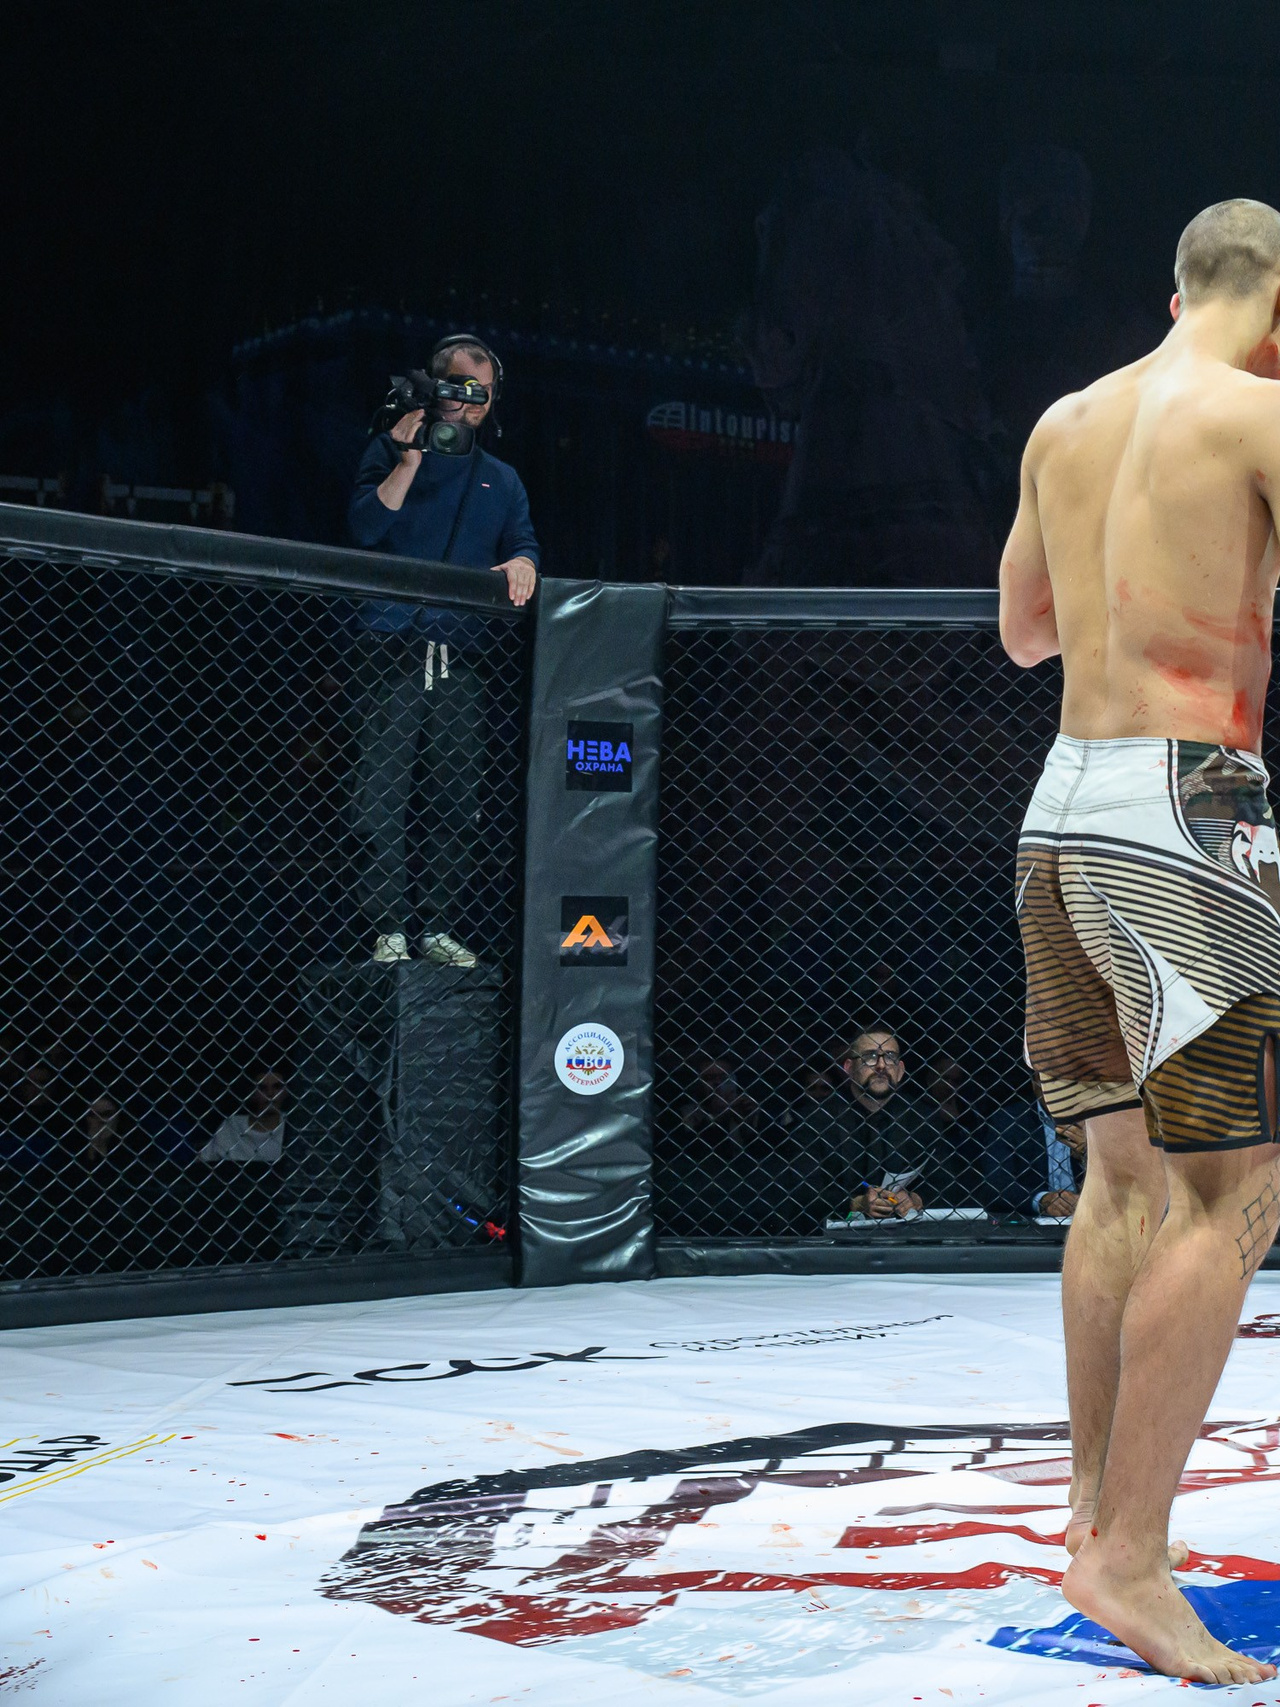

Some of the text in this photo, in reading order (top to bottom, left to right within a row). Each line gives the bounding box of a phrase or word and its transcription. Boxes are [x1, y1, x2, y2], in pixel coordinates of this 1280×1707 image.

[567, 739, 632, 762] НЕВА
[575, 761, 624, 773] ОХРАНА
[565, 1032, 615, 1053] АССОЦИАЦИЯ
[571, 1055, 607, 1069] СВО
[567, 1071, 610, 1086] ВЕТЕРАНОВ
